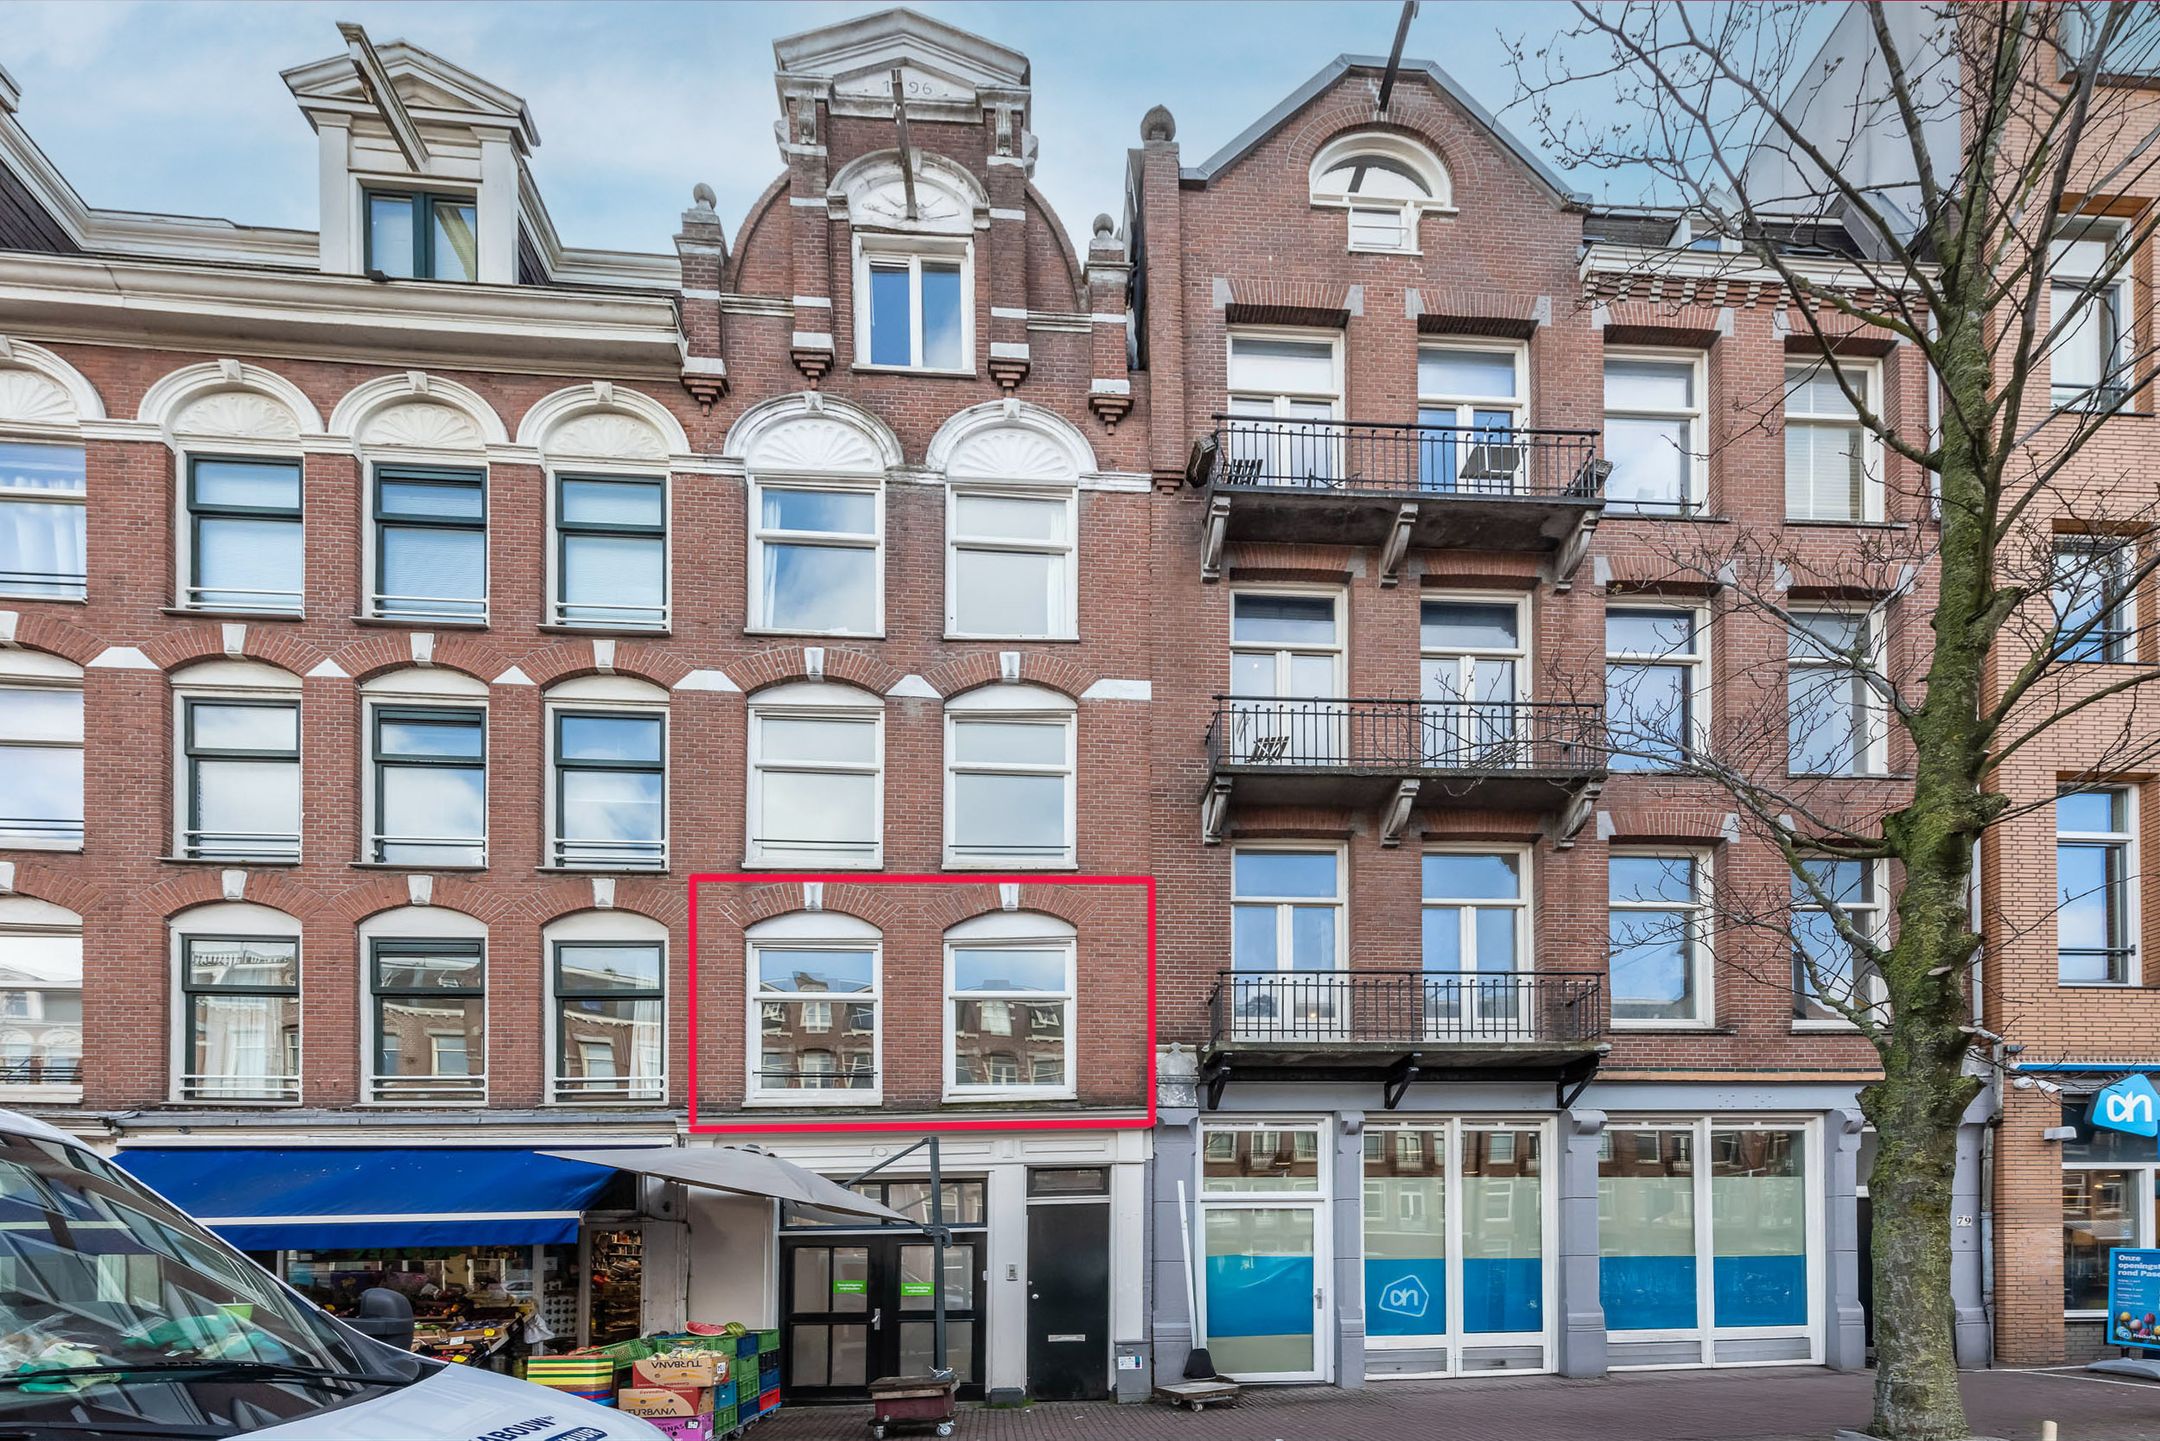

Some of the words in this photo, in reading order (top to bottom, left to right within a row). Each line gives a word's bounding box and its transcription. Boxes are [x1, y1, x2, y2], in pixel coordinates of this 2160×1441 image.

[882, 80, 933, 95] 196
[1957, 1216, 1971, 1225] 79
[651, 1360, 702, 1369] TURBANA
